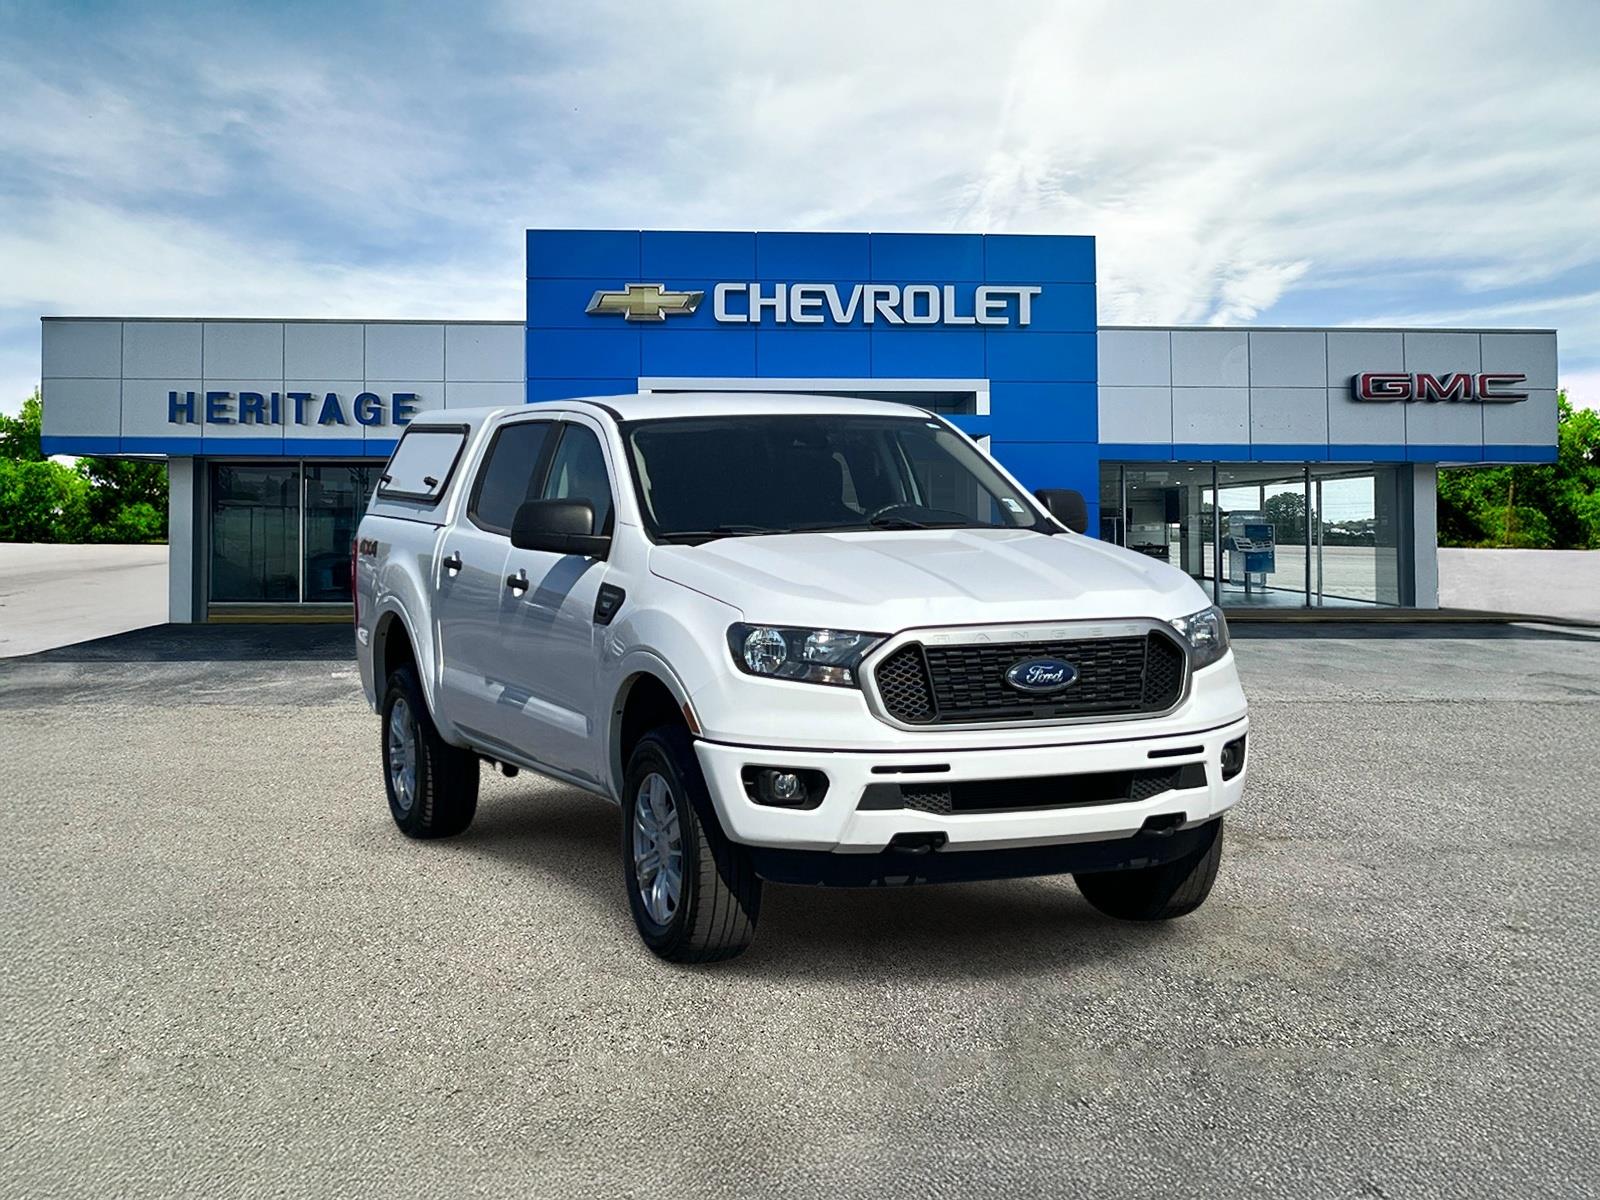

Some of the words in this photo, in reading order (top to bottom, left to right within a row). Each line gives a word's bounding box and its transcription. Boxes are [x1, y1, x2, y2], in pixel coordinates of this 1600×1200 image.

[713, 282, 1042, 326] CHEVROLET
[1353, 372, 1529, 402] GMC
[168, 391, 419, 426] HERITAGE
[1026, 665, 1064, 684] Ford
